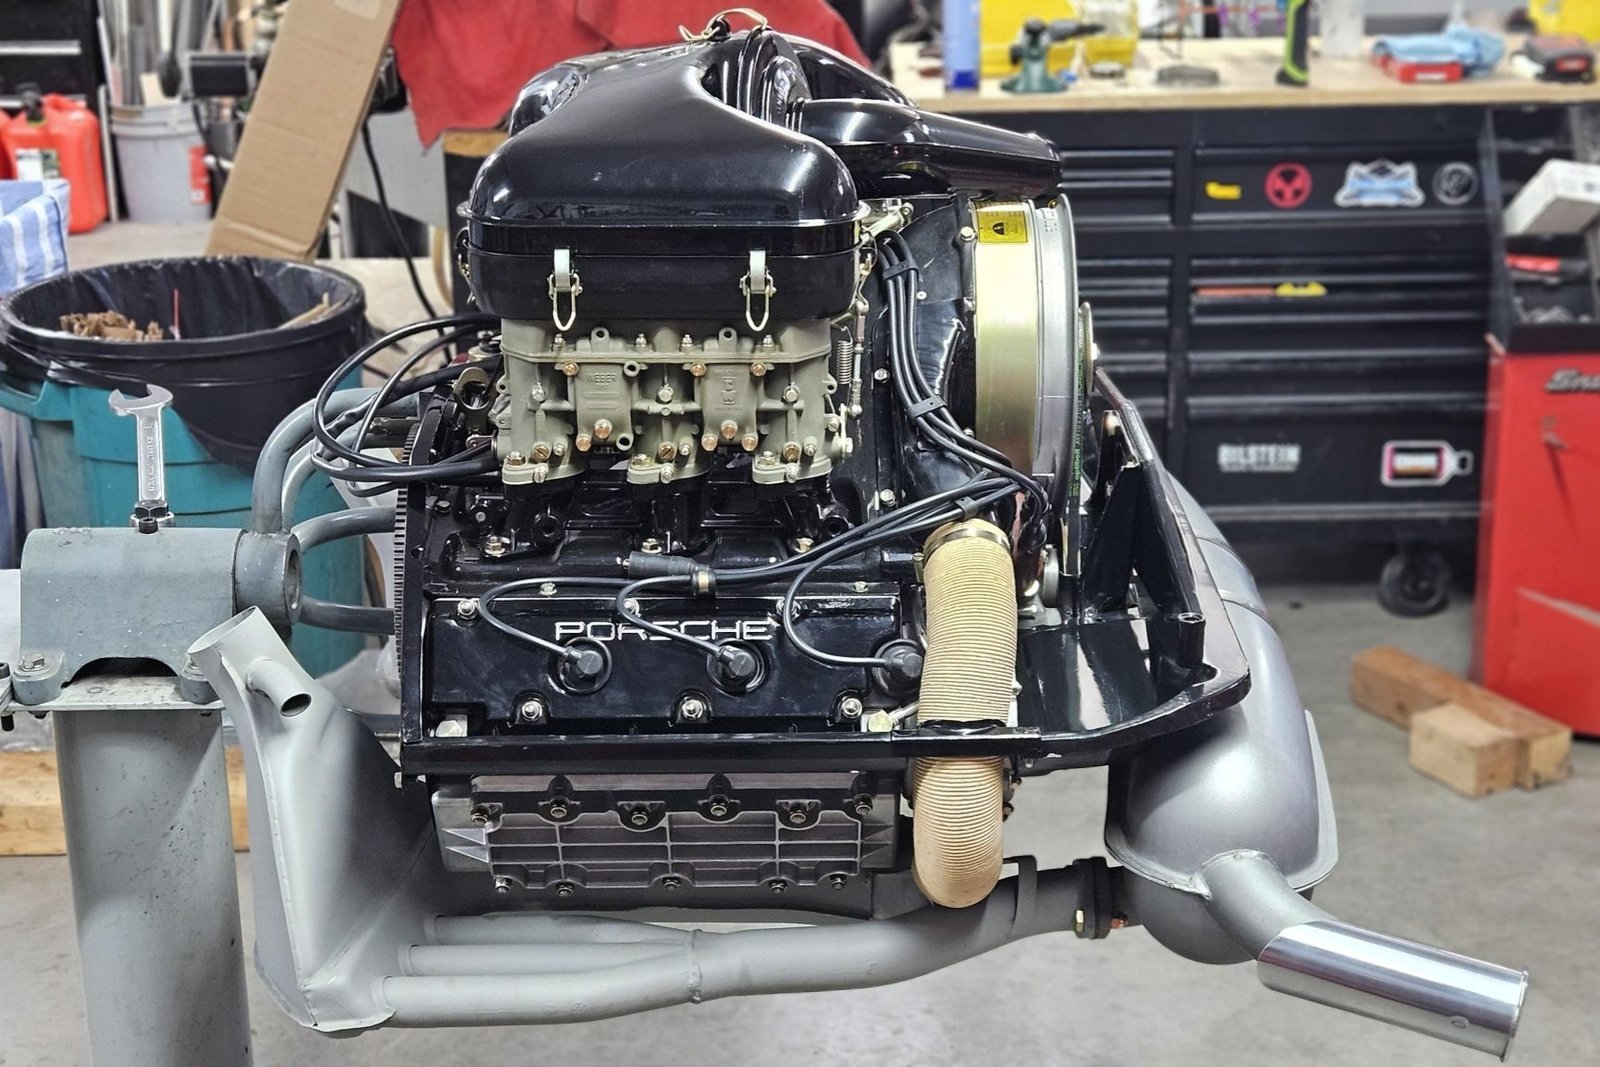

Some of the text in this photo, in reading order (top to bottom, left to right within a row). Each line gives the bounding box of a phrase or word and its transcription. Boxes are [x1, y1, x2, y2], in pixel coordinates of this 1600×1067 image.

[585, 372, 617, 384] WEBER
[1218, 443, 1301, 463] BILSTEIN
[1074, 448, 1082, 480] optibelt
[554, 619, 773, 641] PORSCHE
